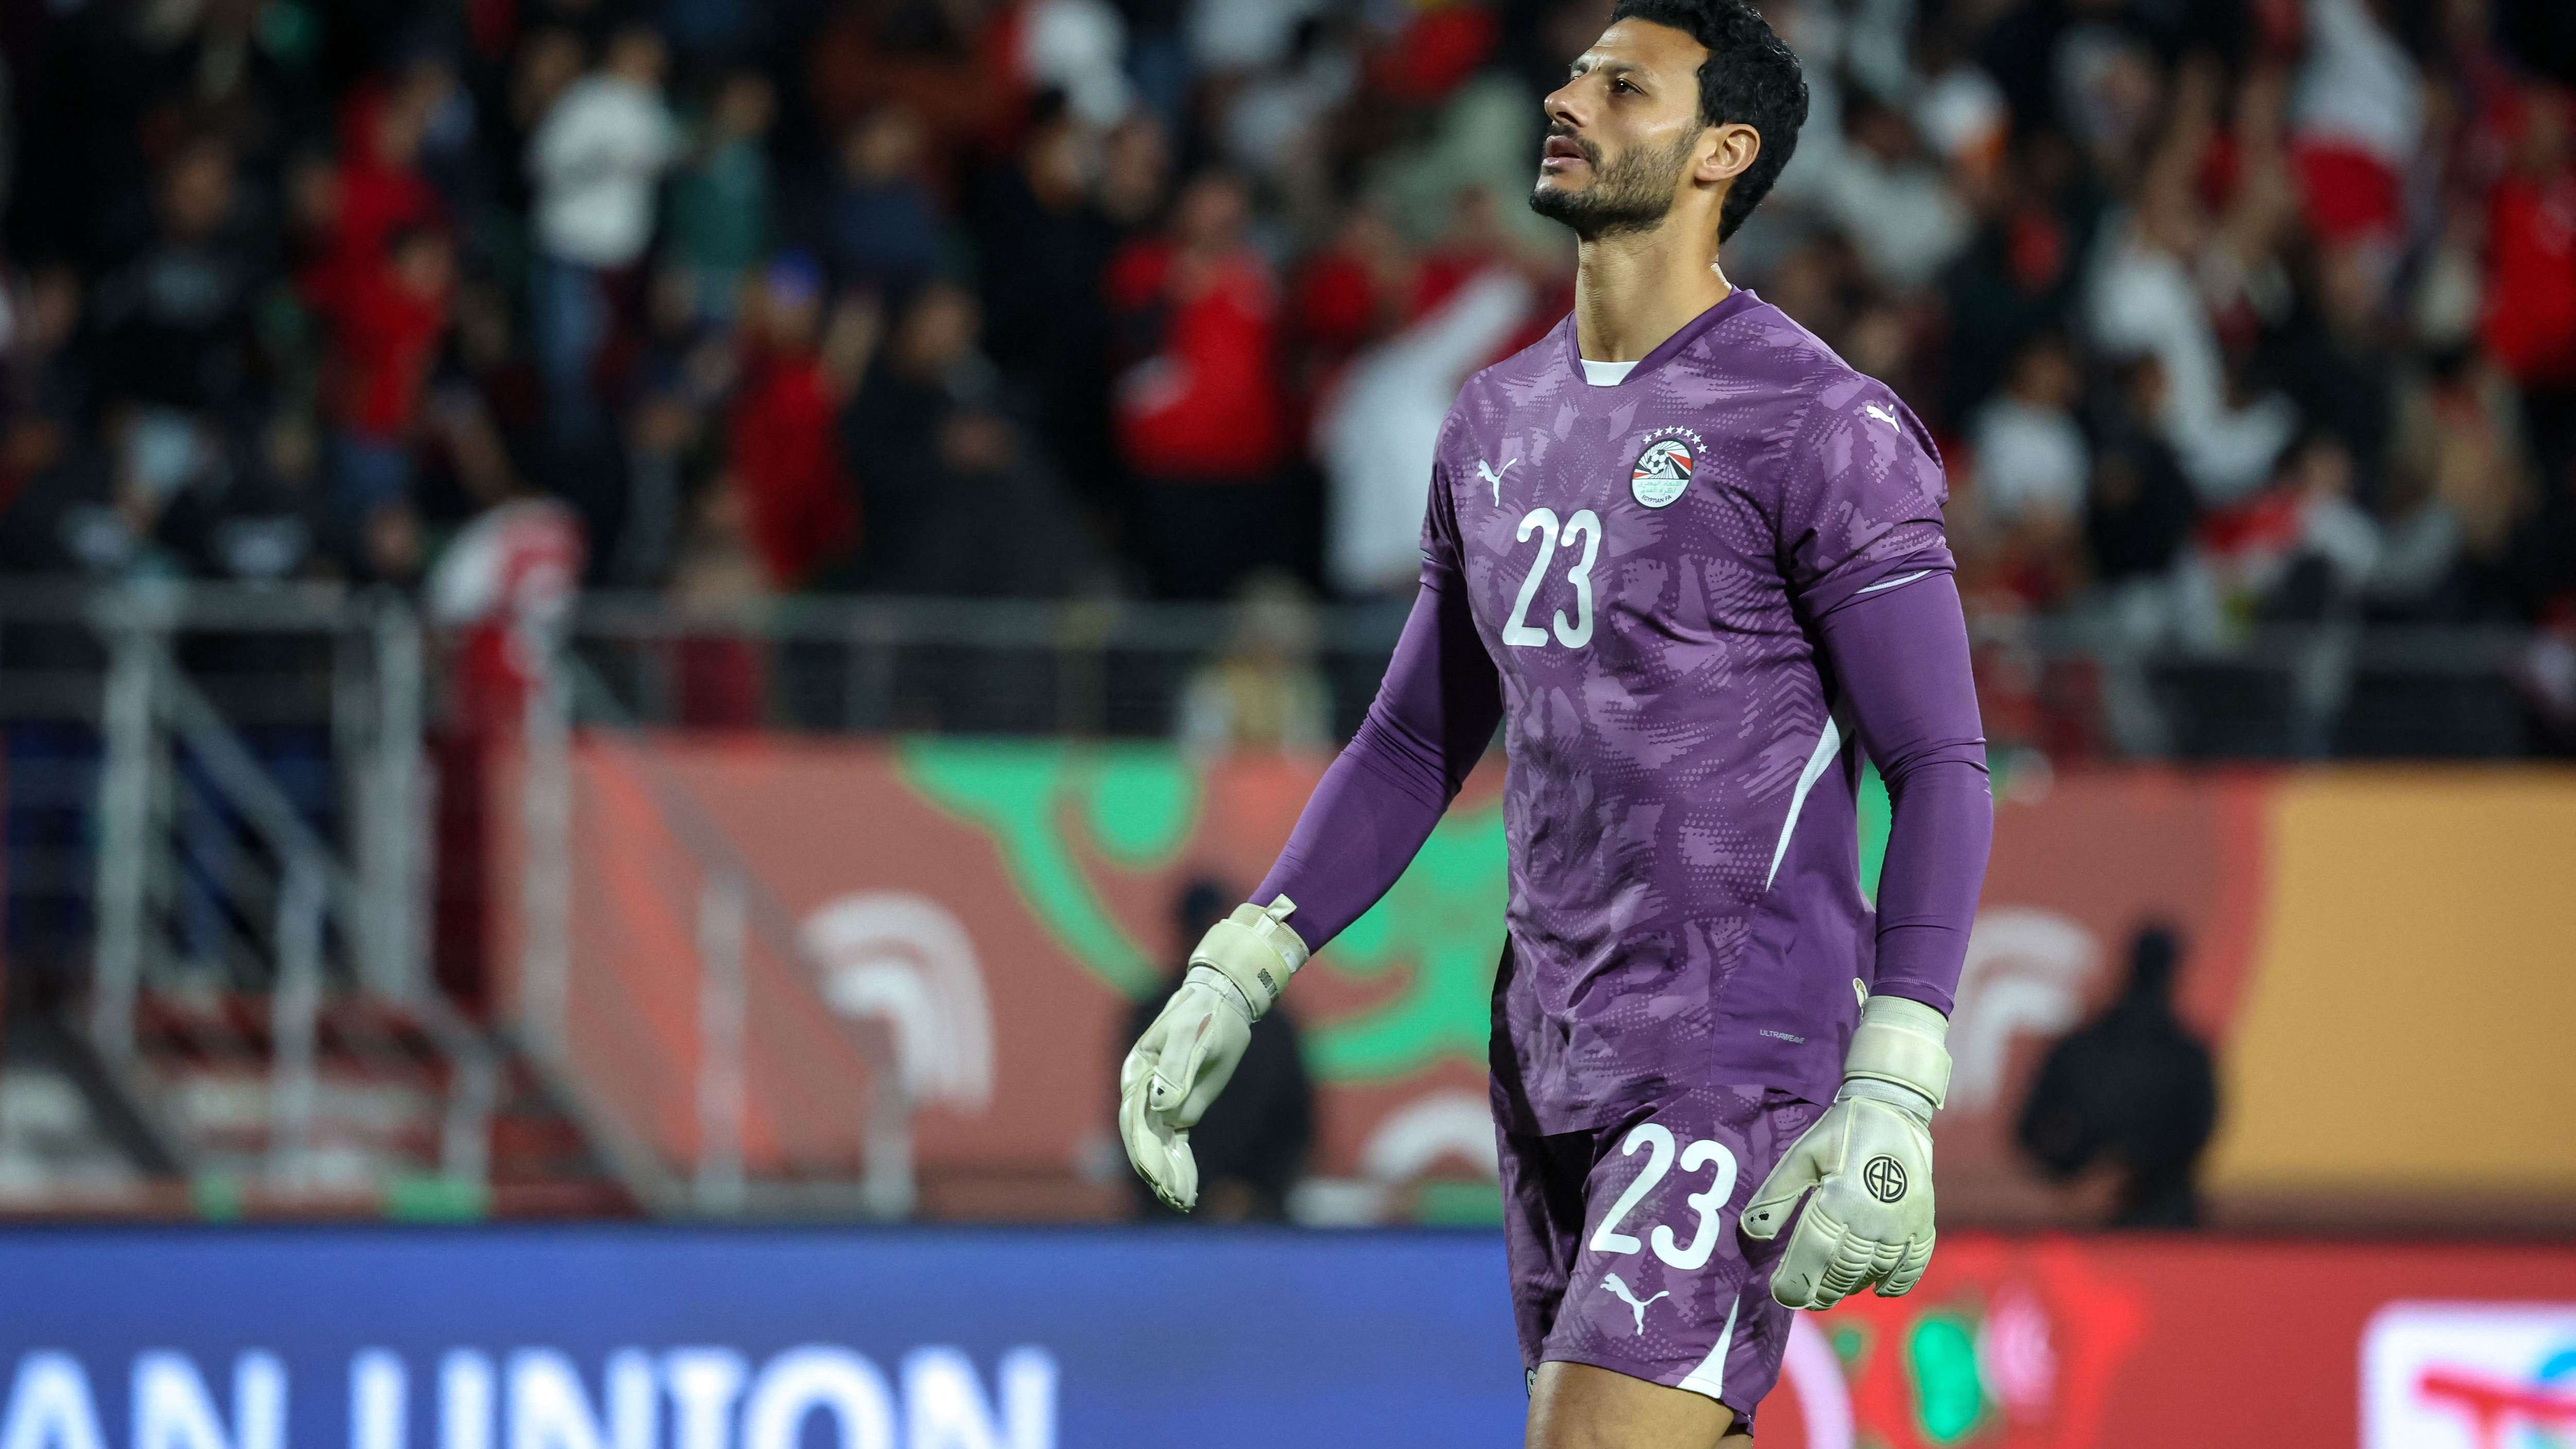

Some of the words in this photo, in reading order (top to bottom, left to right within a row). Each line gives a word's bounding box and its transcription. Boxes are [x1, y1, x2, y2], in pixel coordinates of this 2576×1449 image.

[1642, 494, 1664, 503] EGYPTIAN
[1502, 507, 1602, 649] 23
[1589, 1123, 1738, 1270] 23
